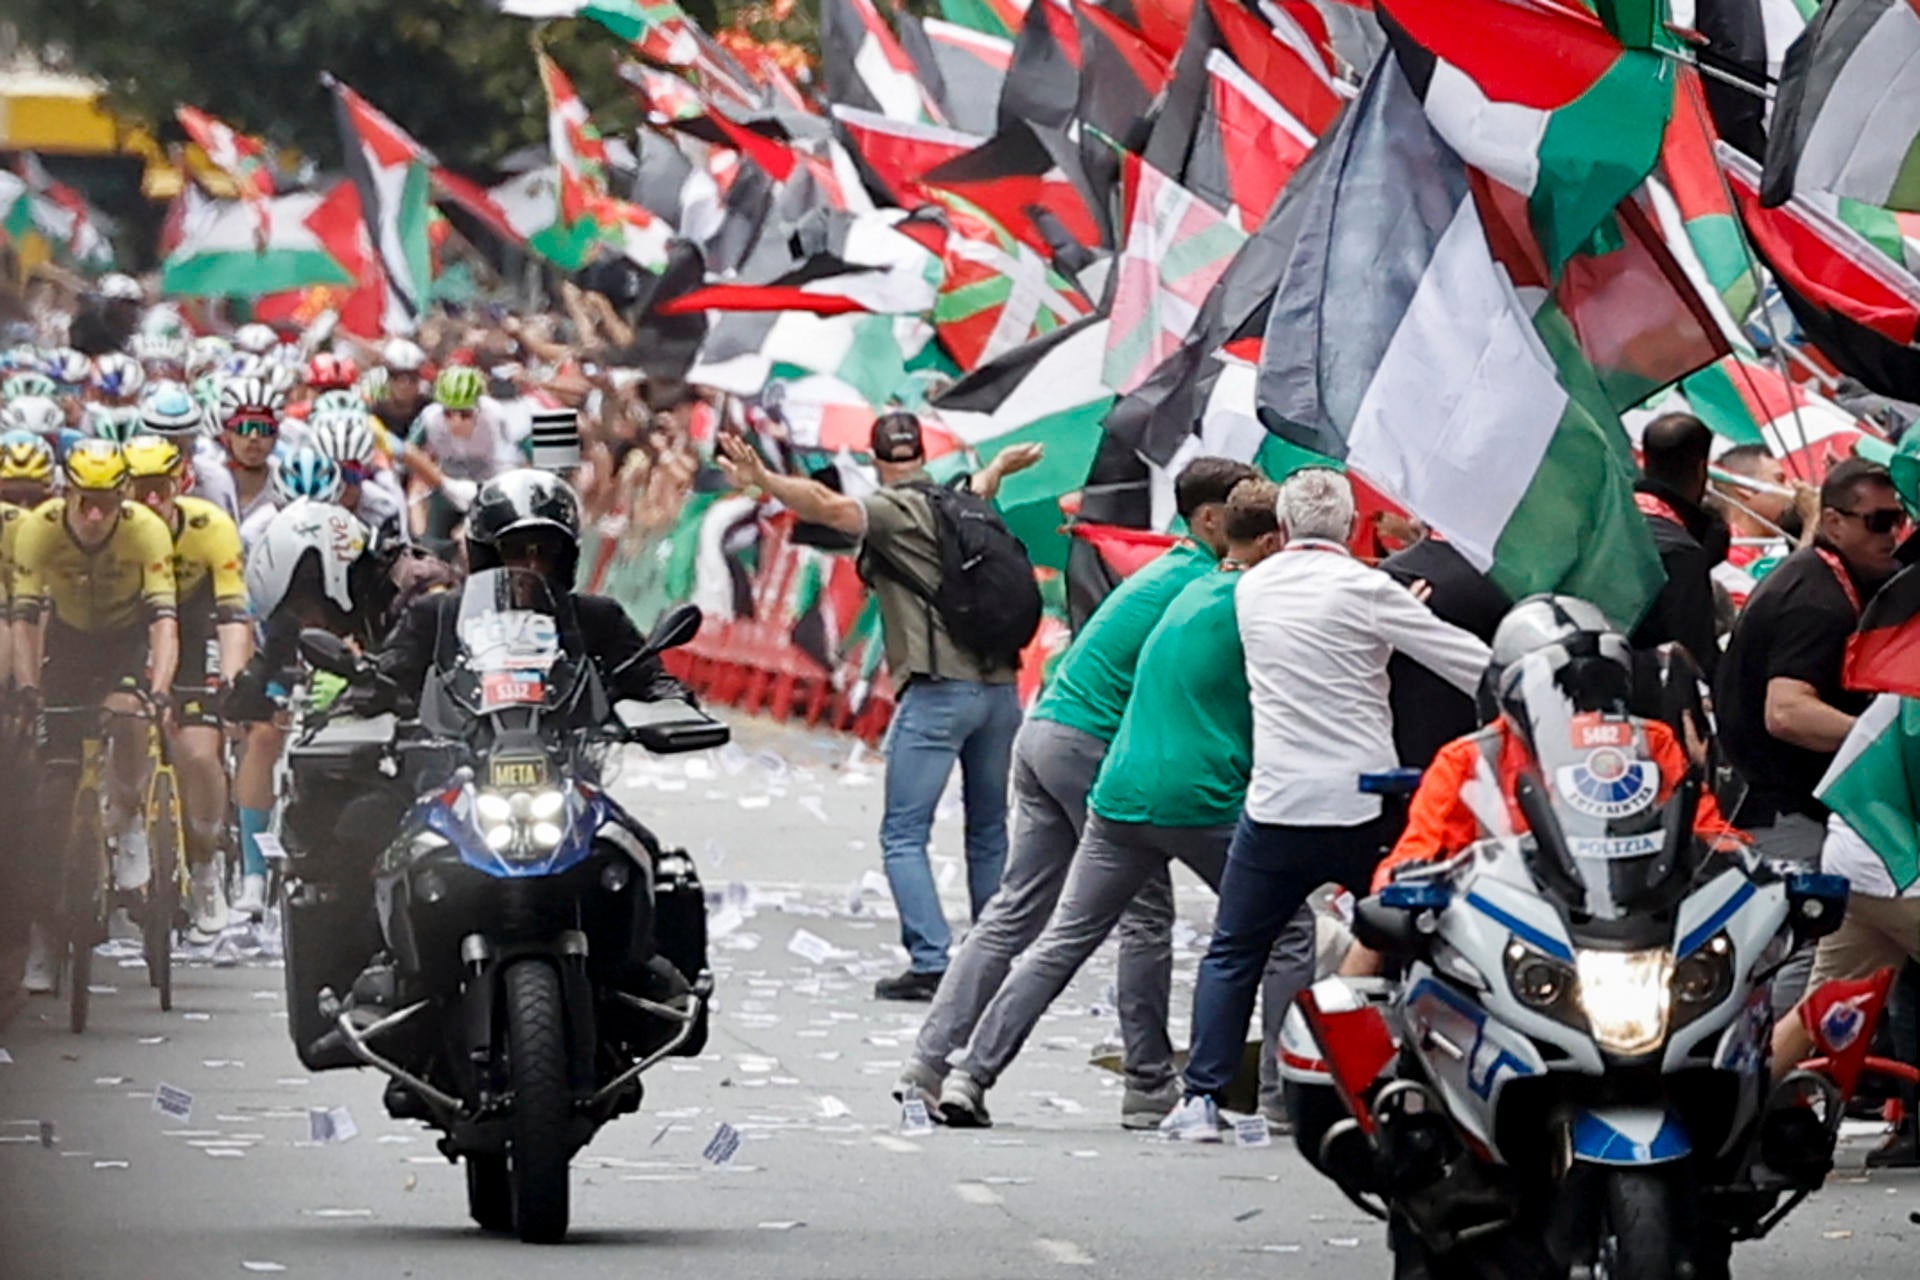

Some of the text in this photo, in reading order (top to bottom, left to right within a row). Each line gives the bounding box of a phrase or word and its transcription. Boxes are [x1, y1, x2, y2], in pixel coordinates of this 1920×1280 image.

[329, 515, 353, 562] rtve
[495, 764, 538, 786] META
[1577, 837, 1655, 854] POLIZIA
